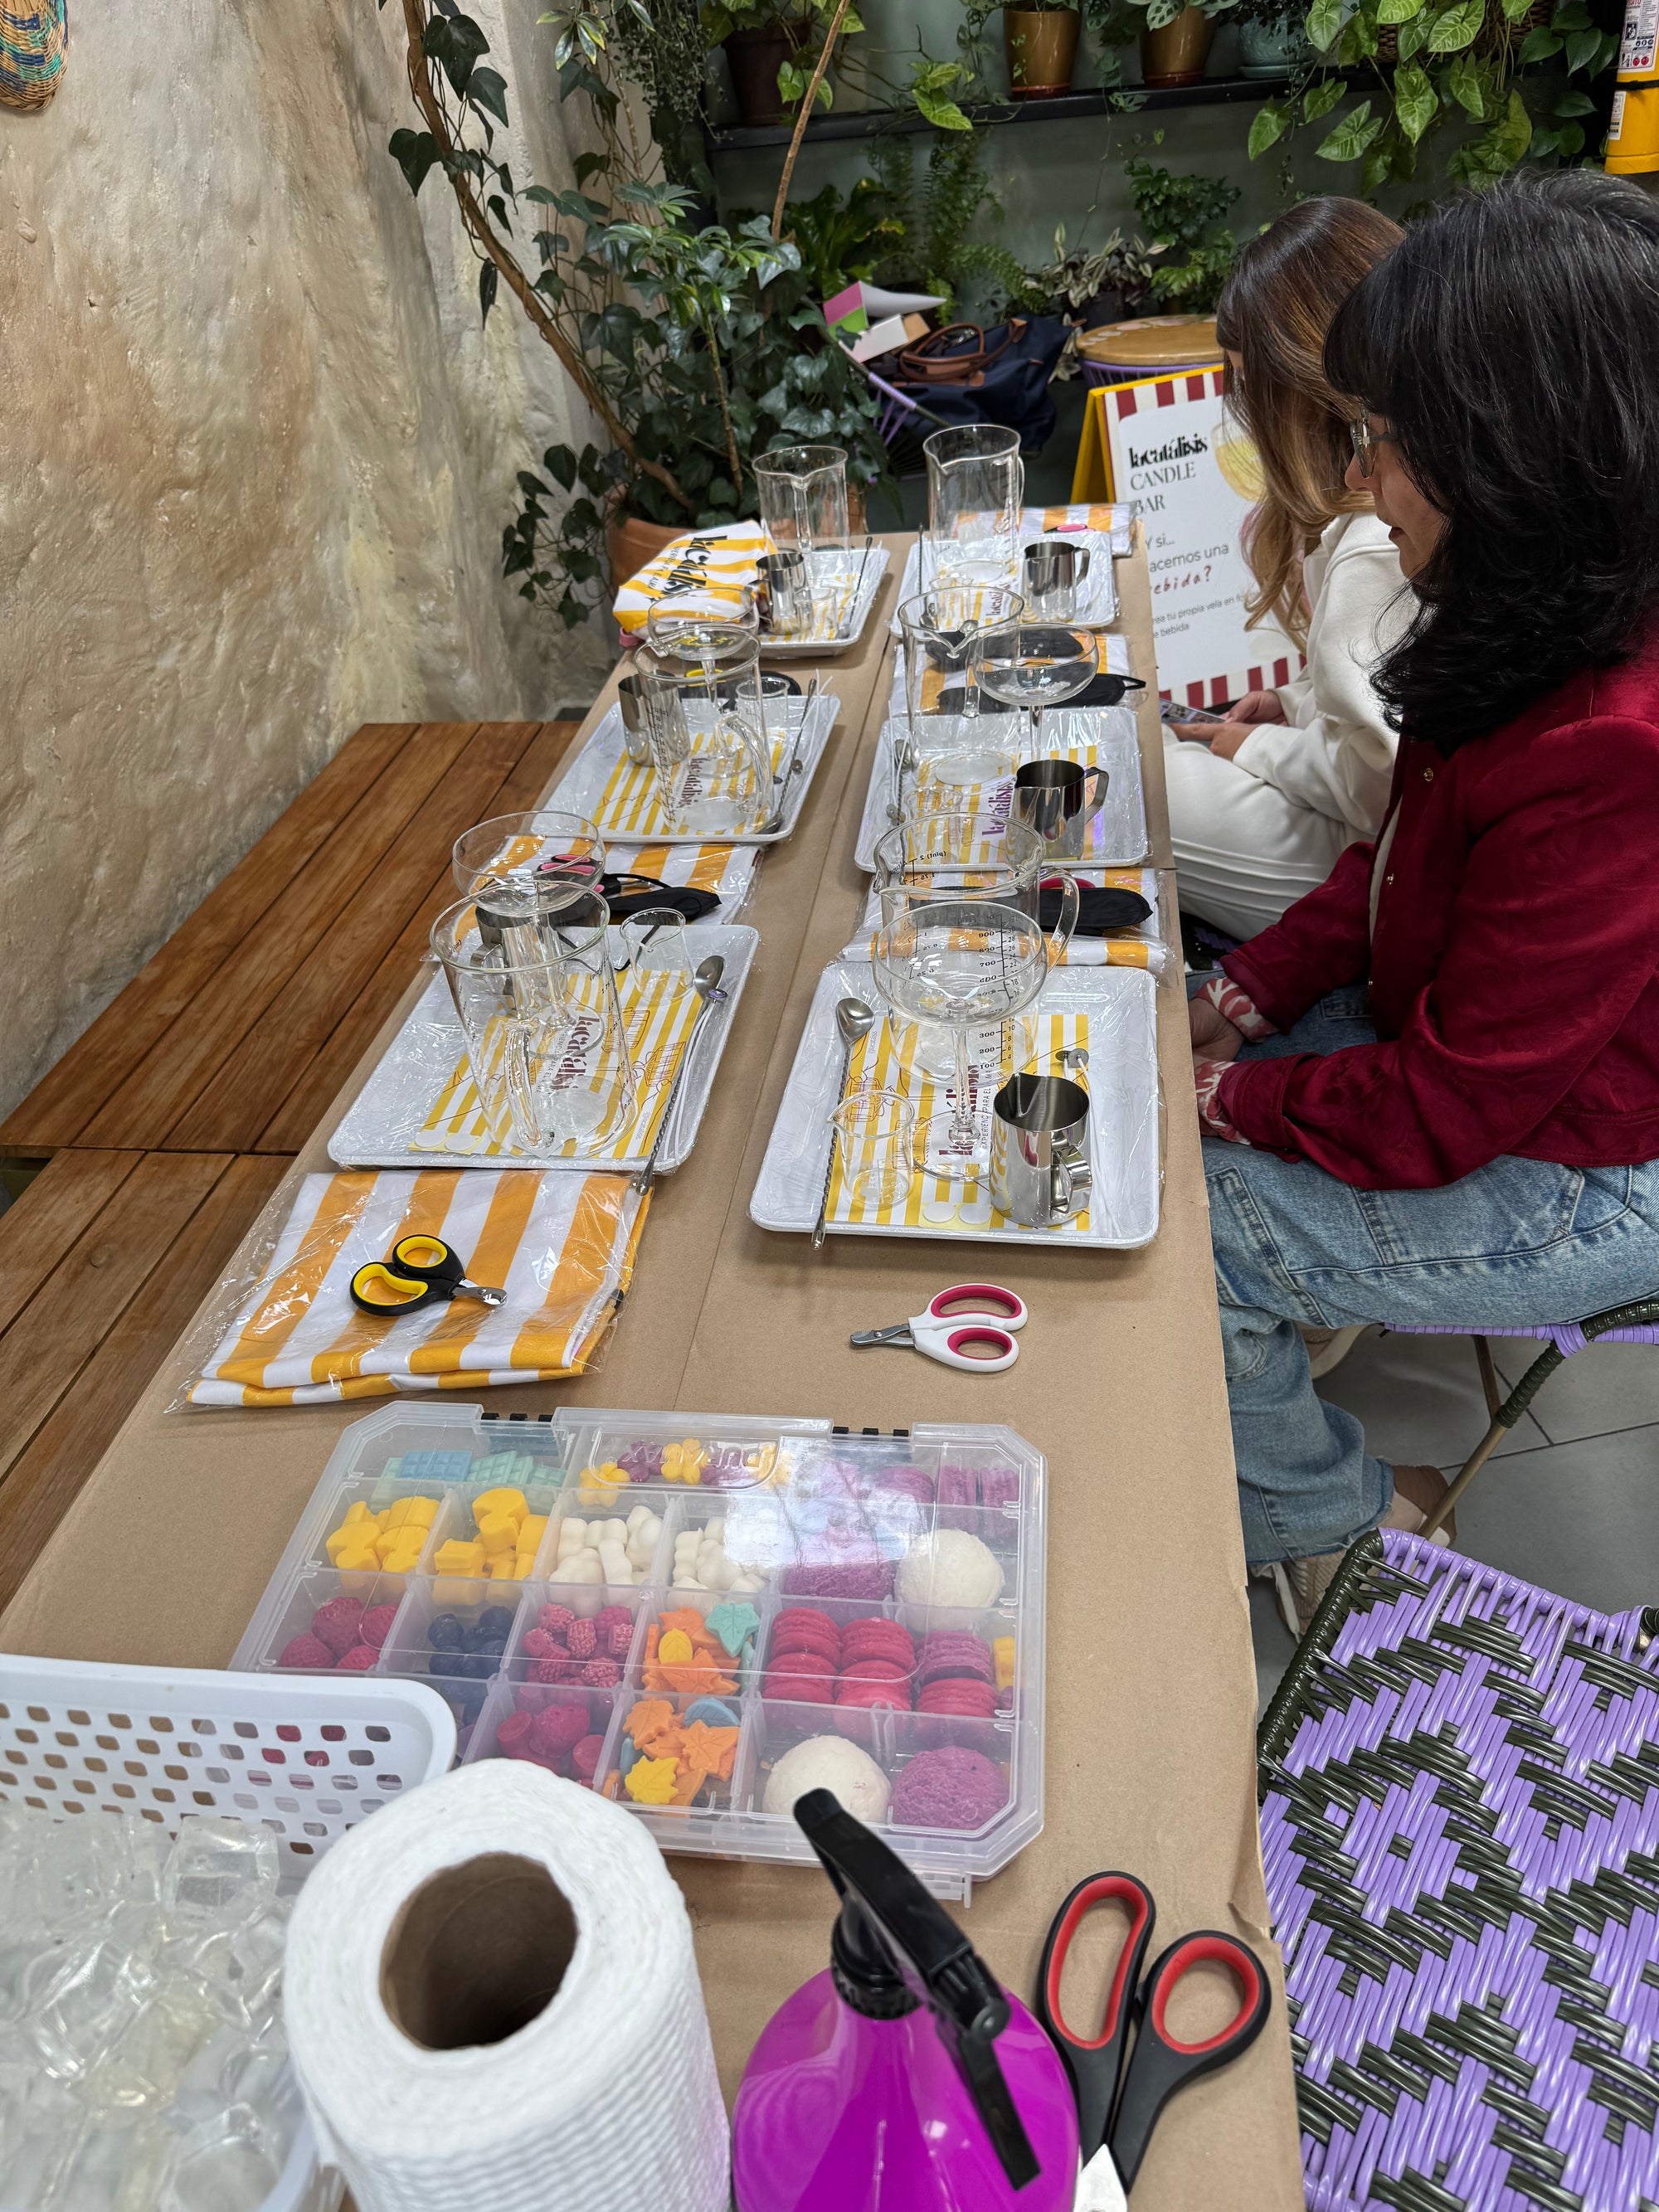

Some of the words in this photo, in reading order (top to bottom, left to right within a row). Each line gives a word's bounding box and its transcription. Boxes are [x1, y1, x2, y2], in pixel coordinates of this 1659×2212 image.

[1130, 461, 1196, 491] CANDLE
[1149, 551, 1201, 572] acemos
[1204, 543, 1229, 559] una
[1151, 565, 1212, 595] ebida?
[1178, 605, 1205, 620] propia
